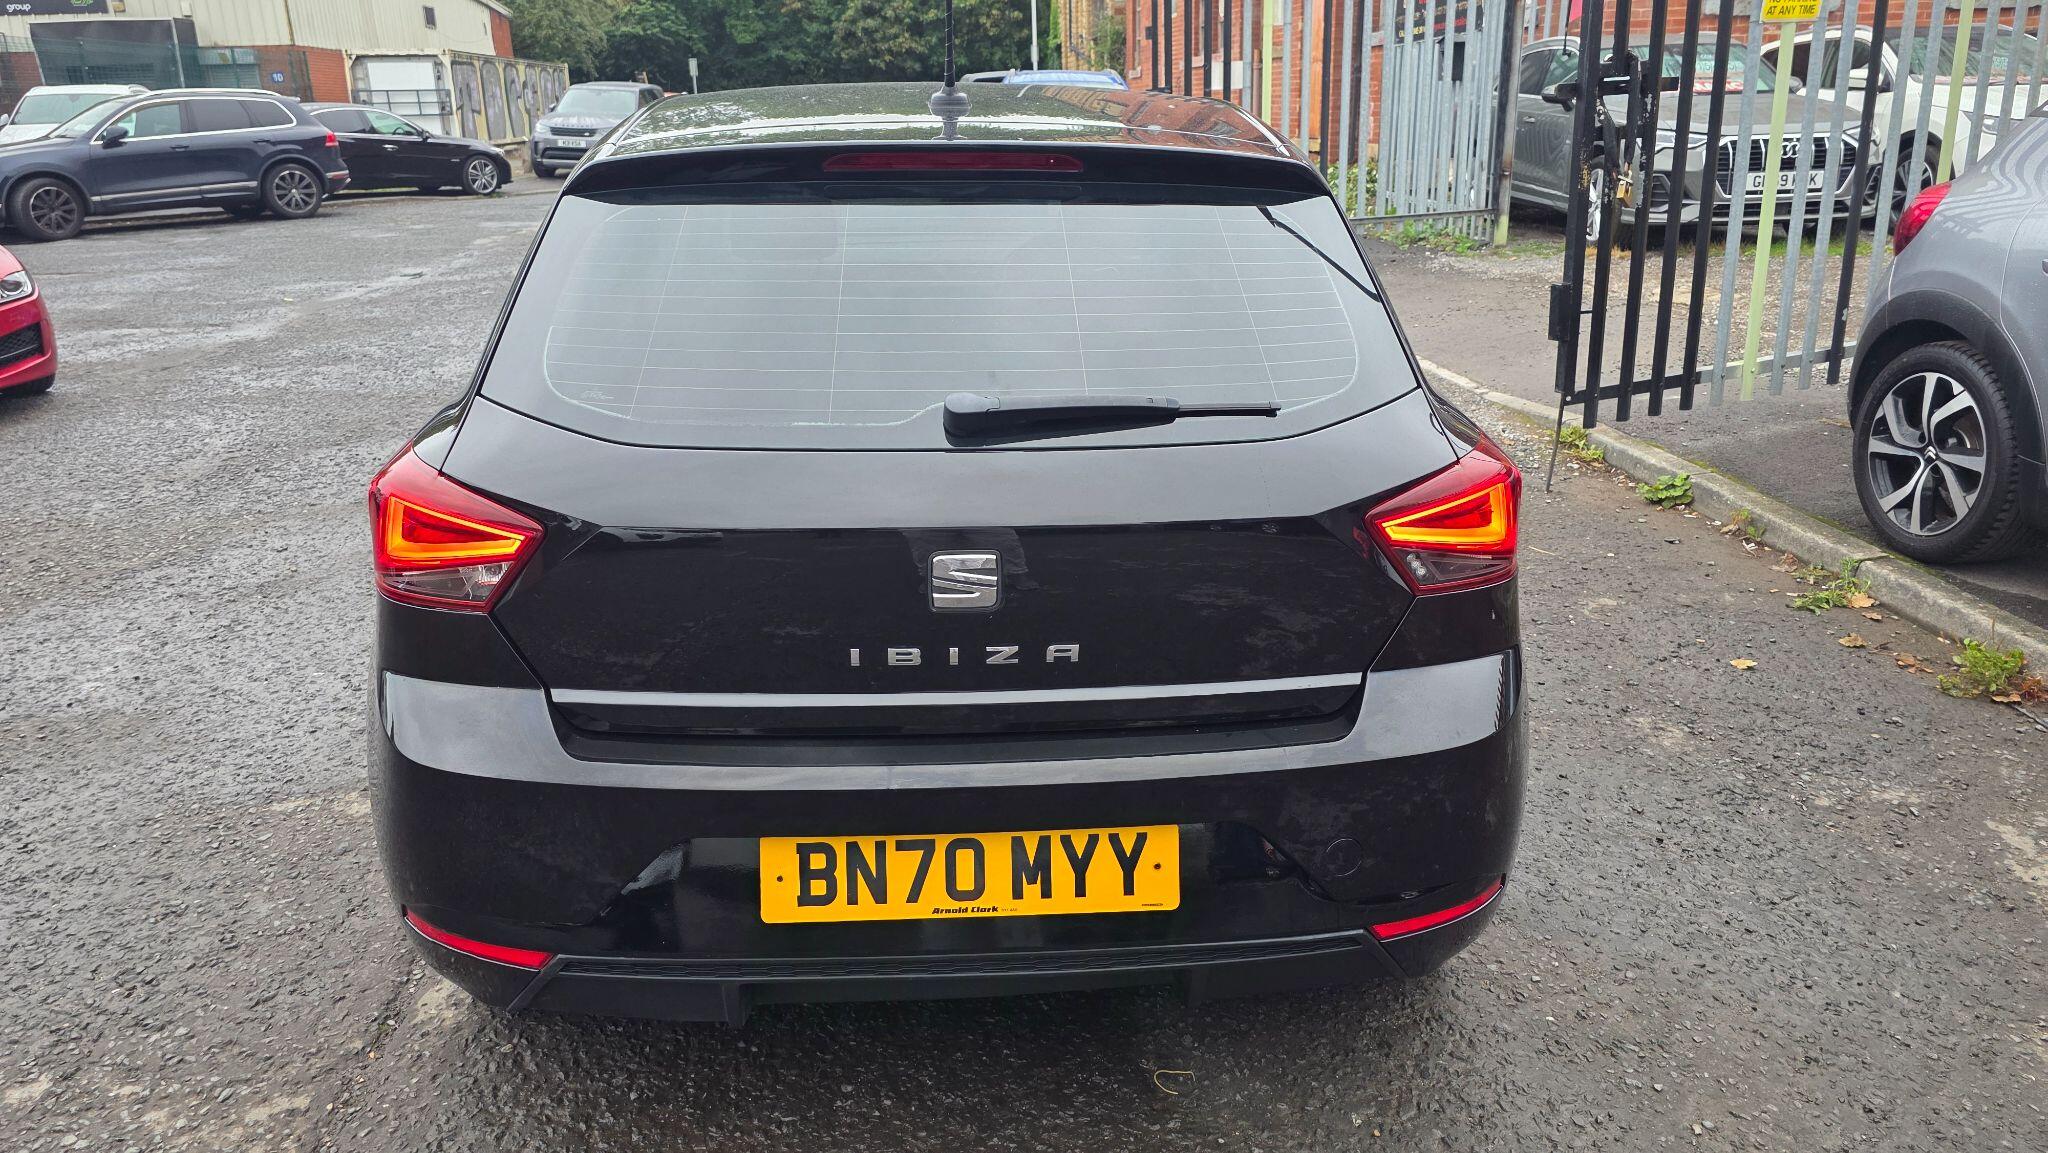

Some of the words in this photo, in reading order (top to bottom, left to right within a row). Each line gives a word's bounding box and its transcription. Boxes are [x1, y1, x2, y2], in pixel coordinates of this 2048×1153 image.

[6, 4, 31, 12] group
[1766, 5, 1777, 15] AT
[1778, 5, 1797, 15] ANY
[1799, 4, 1816, 14] TIME
[850, 644, 1080, 666] IBIZA
[796, 837, 986, 907] BN70
[1010, 832, 1148, 900] MYY
[931, 906, 969, 914] Arnold
[970, 905, 999, 913] Clark
